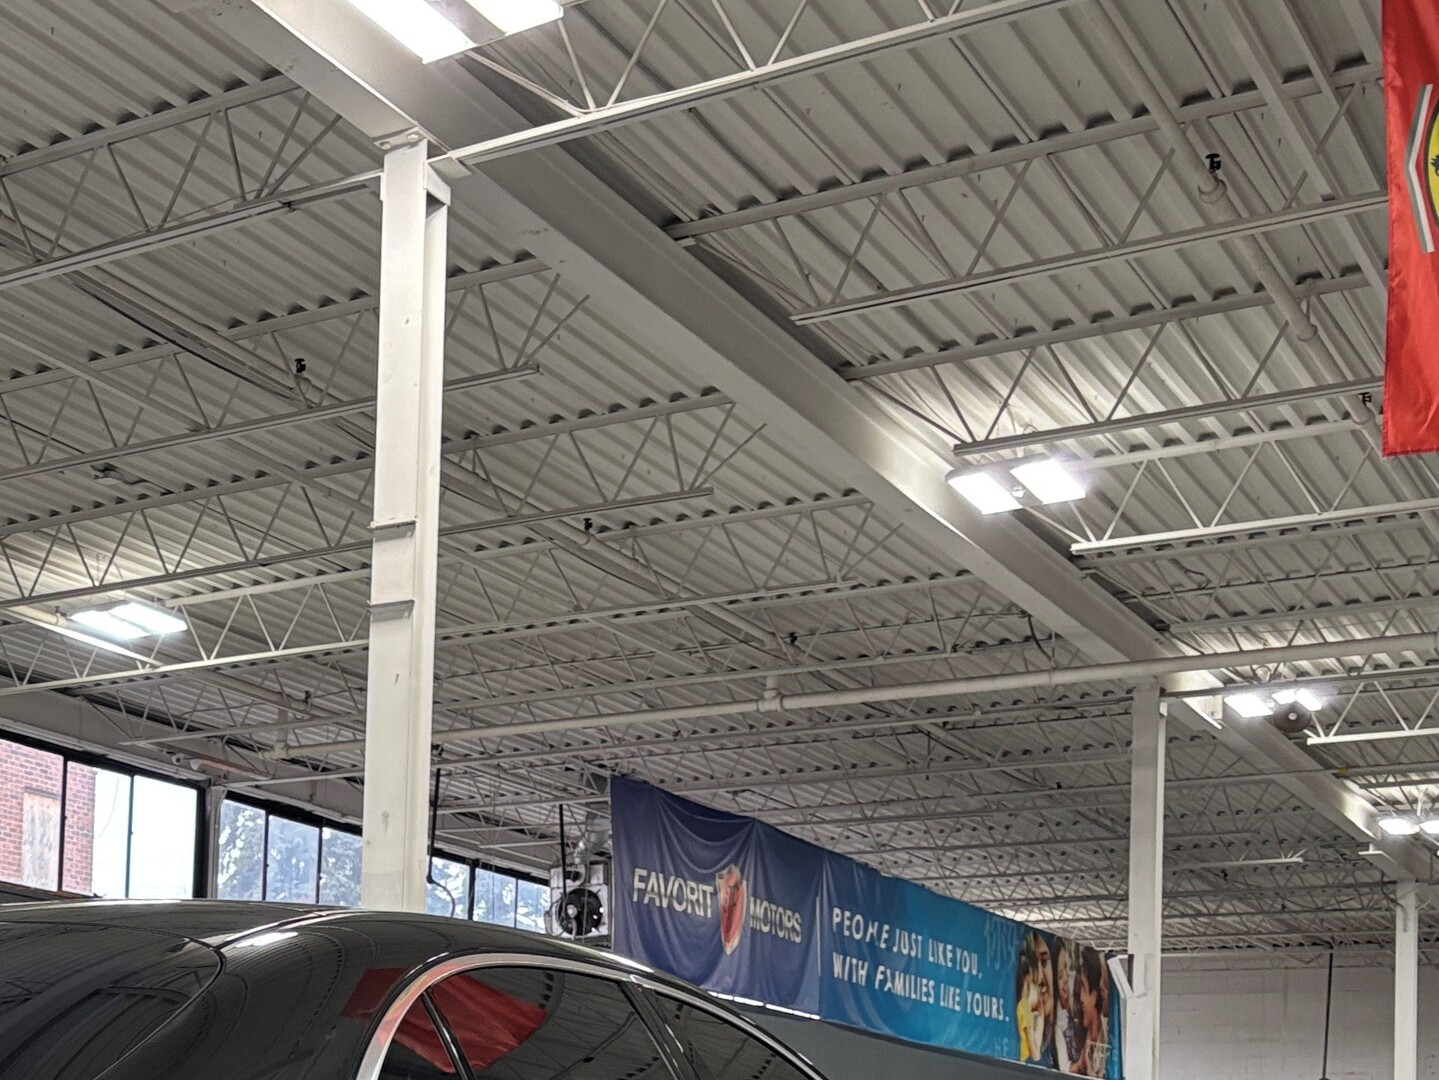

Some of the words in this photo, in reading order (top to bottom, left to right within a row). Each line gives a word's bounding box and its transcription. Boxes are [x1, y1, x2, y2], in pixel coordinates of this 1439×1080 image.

[633, 868, 714, 919] FAVORIT
[750, 896, 802, 944] MOTORS
[893, 928, 923, 960] JUST
[928, 938, 953, 968] LIKE
[833, 951, 868, 986] WITH
[875, 965, 936, 1004] FAMILIES
[940, 983, 961, 1012] LIKE
